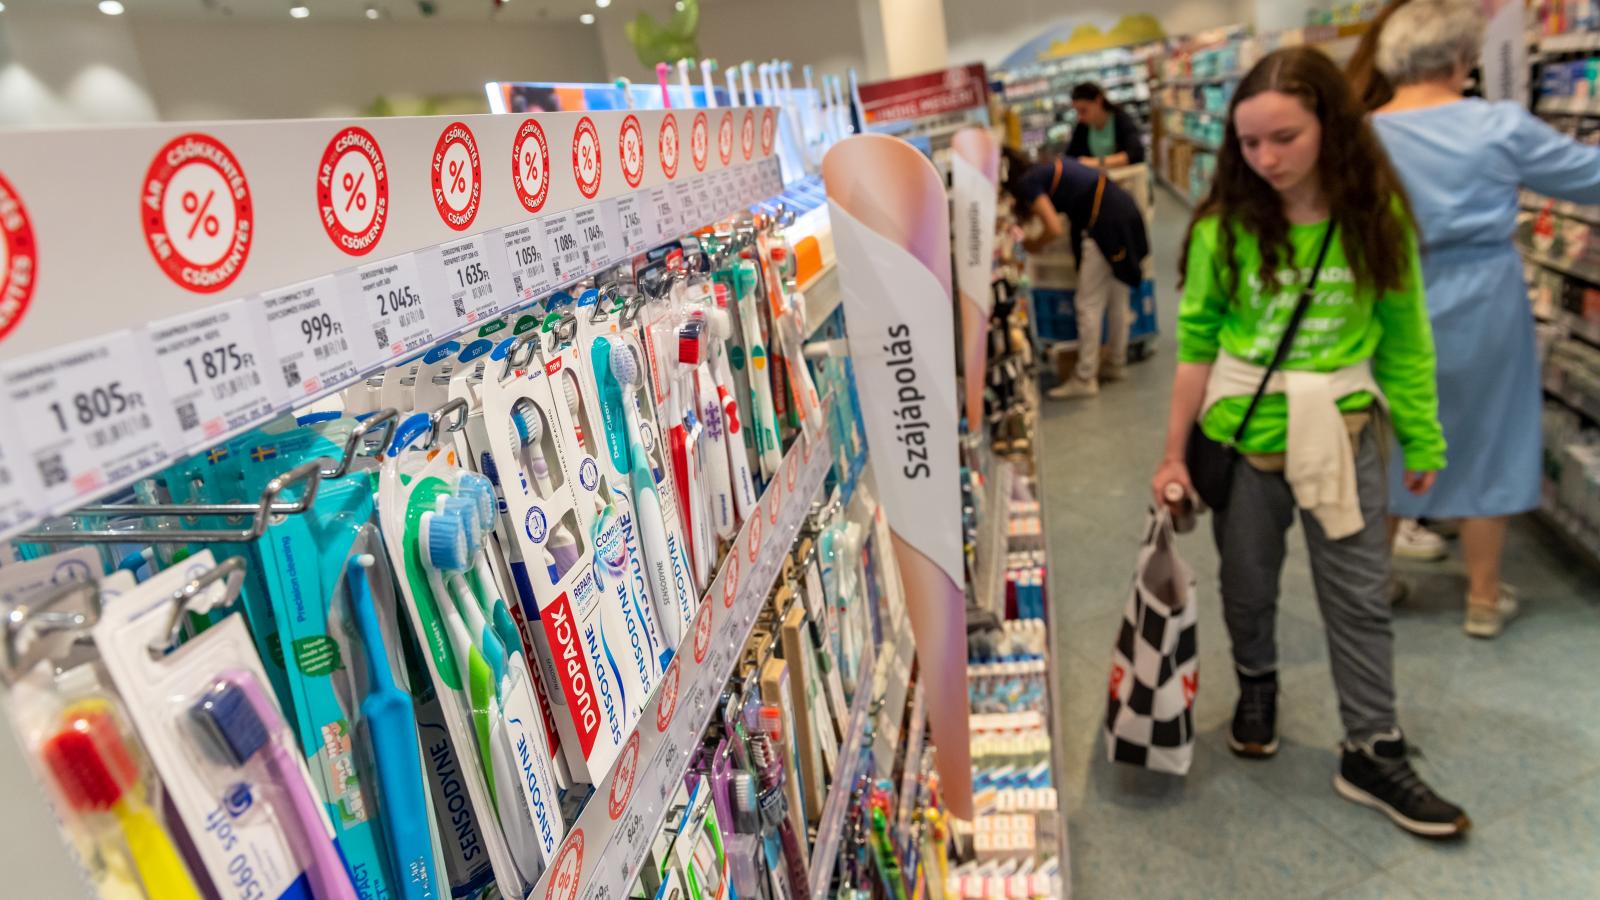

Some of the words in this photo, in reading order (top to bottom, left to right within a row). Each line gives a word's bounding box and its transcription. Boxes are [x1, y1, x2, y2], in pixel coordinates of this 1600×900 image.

[319, 164, 332, 188] ÁR
[335, 131, 384, 181] CSÖKKENTÉS
[433, 152, 442, 172] ÁR
[341, 198, 385, 249] CSÖKKENTÉS
[301, 313, 343, 344] 999Ft
[604, 401, 613, 431] Clean
[887, 323, 931, 479] Szájápolás
[610, 433, 620, 459] Deep
[292, 577, 306, 623] Precision
[573, 572, 592, 599] REPAIR
[656, 560, 671, 606] SENSODYNE
[667, 531, 692, 629] ENSODYNE
[616, 580, 652, 695] SENSODYNE
[550, 609, 597, 734] DUOPACK
[584, 622, 622, 747] SENSODYNE
[429, 737, 482, 862] SENSODYNE
[516, 734, 554, 855] SENSODYNE
[205, 804, 236, 852] soft
